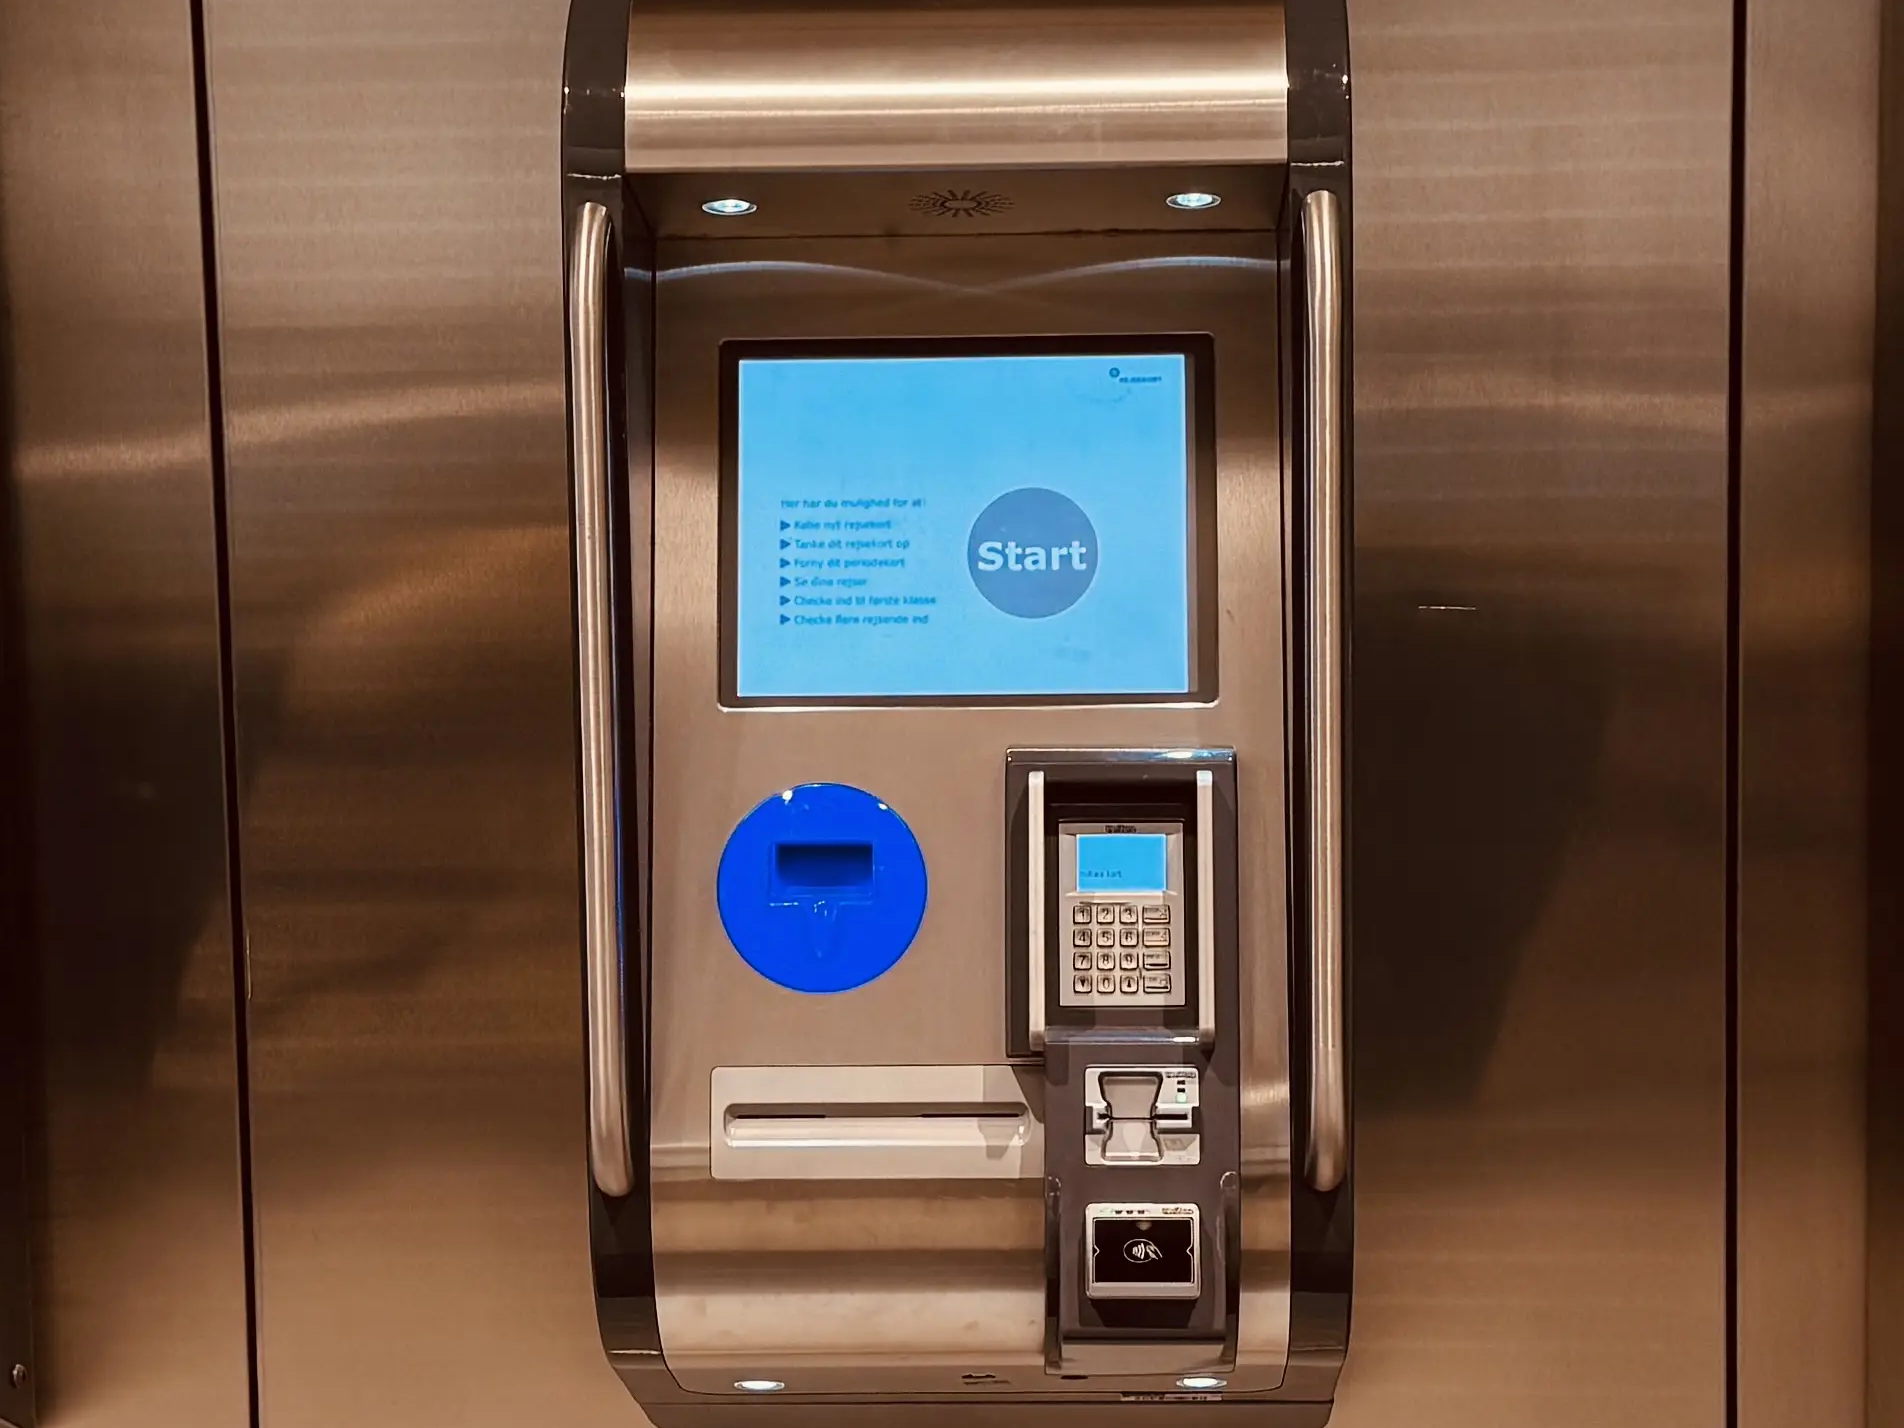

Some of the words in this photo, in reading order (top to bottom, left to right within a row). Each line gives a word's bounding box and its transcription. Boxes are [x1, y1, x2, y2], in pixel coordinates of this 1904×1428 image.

[977, 540, 1087, 572] Start
[1079, 909, 1086, 920] 1
[1102, 908, 1110, 920] 2
[1125, 909, 1133, 920] 3
[1078, 932, 1086, 943] 4
[1102, 932, 1109, 943] 5
[1125, 932, 1132, 943] 6
[1079, 955, 1087, 966] 7
[1102, 955, 1109, 966] 8
[1124, 955, 1133, 965] 9
